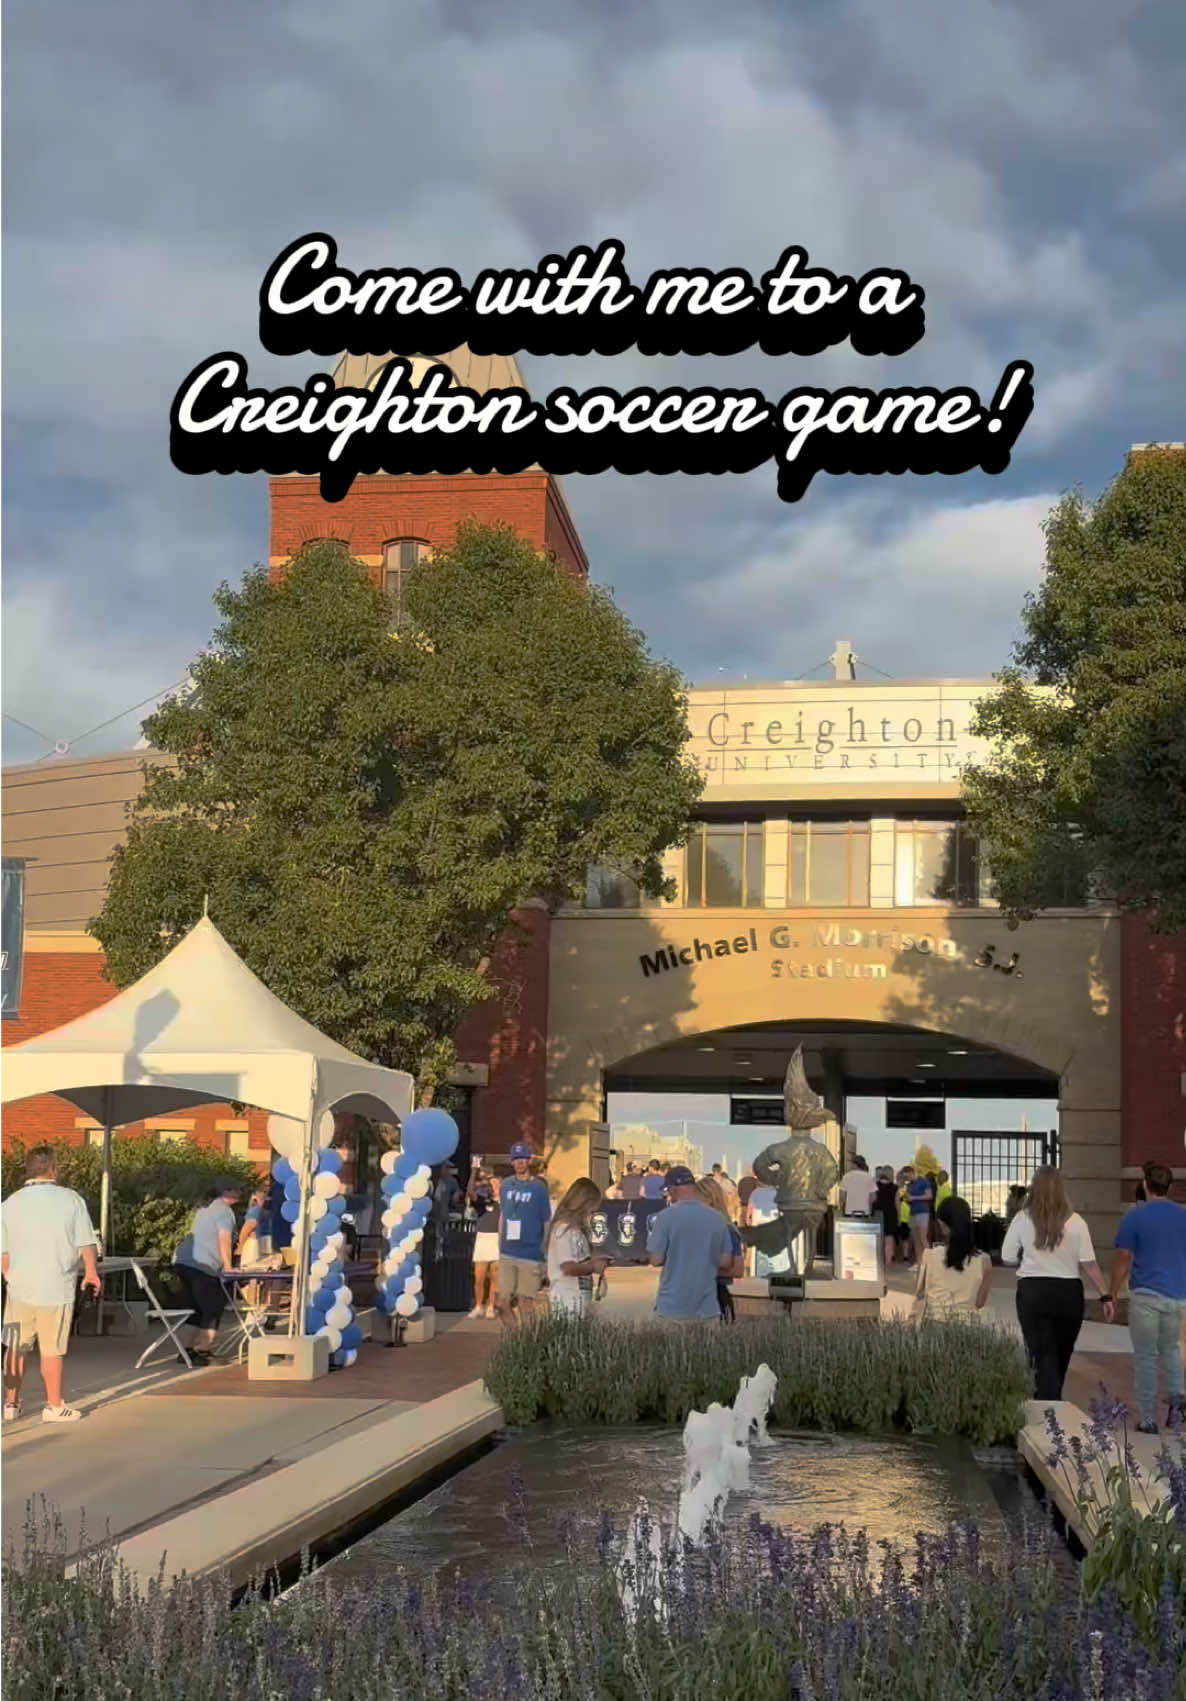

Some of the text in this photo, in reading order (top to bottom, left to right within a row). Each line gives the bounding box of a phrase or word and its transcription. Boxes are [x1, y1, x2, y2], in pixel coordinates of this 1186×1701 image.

[708, 706, 957, 754] Creighton
[705, 752, 955, 772] UNIVERSITY
[638, 928, 758, 978] Michael
[769, 925, 799, 949] G.
[770, 958, 887, 980] Stadium
